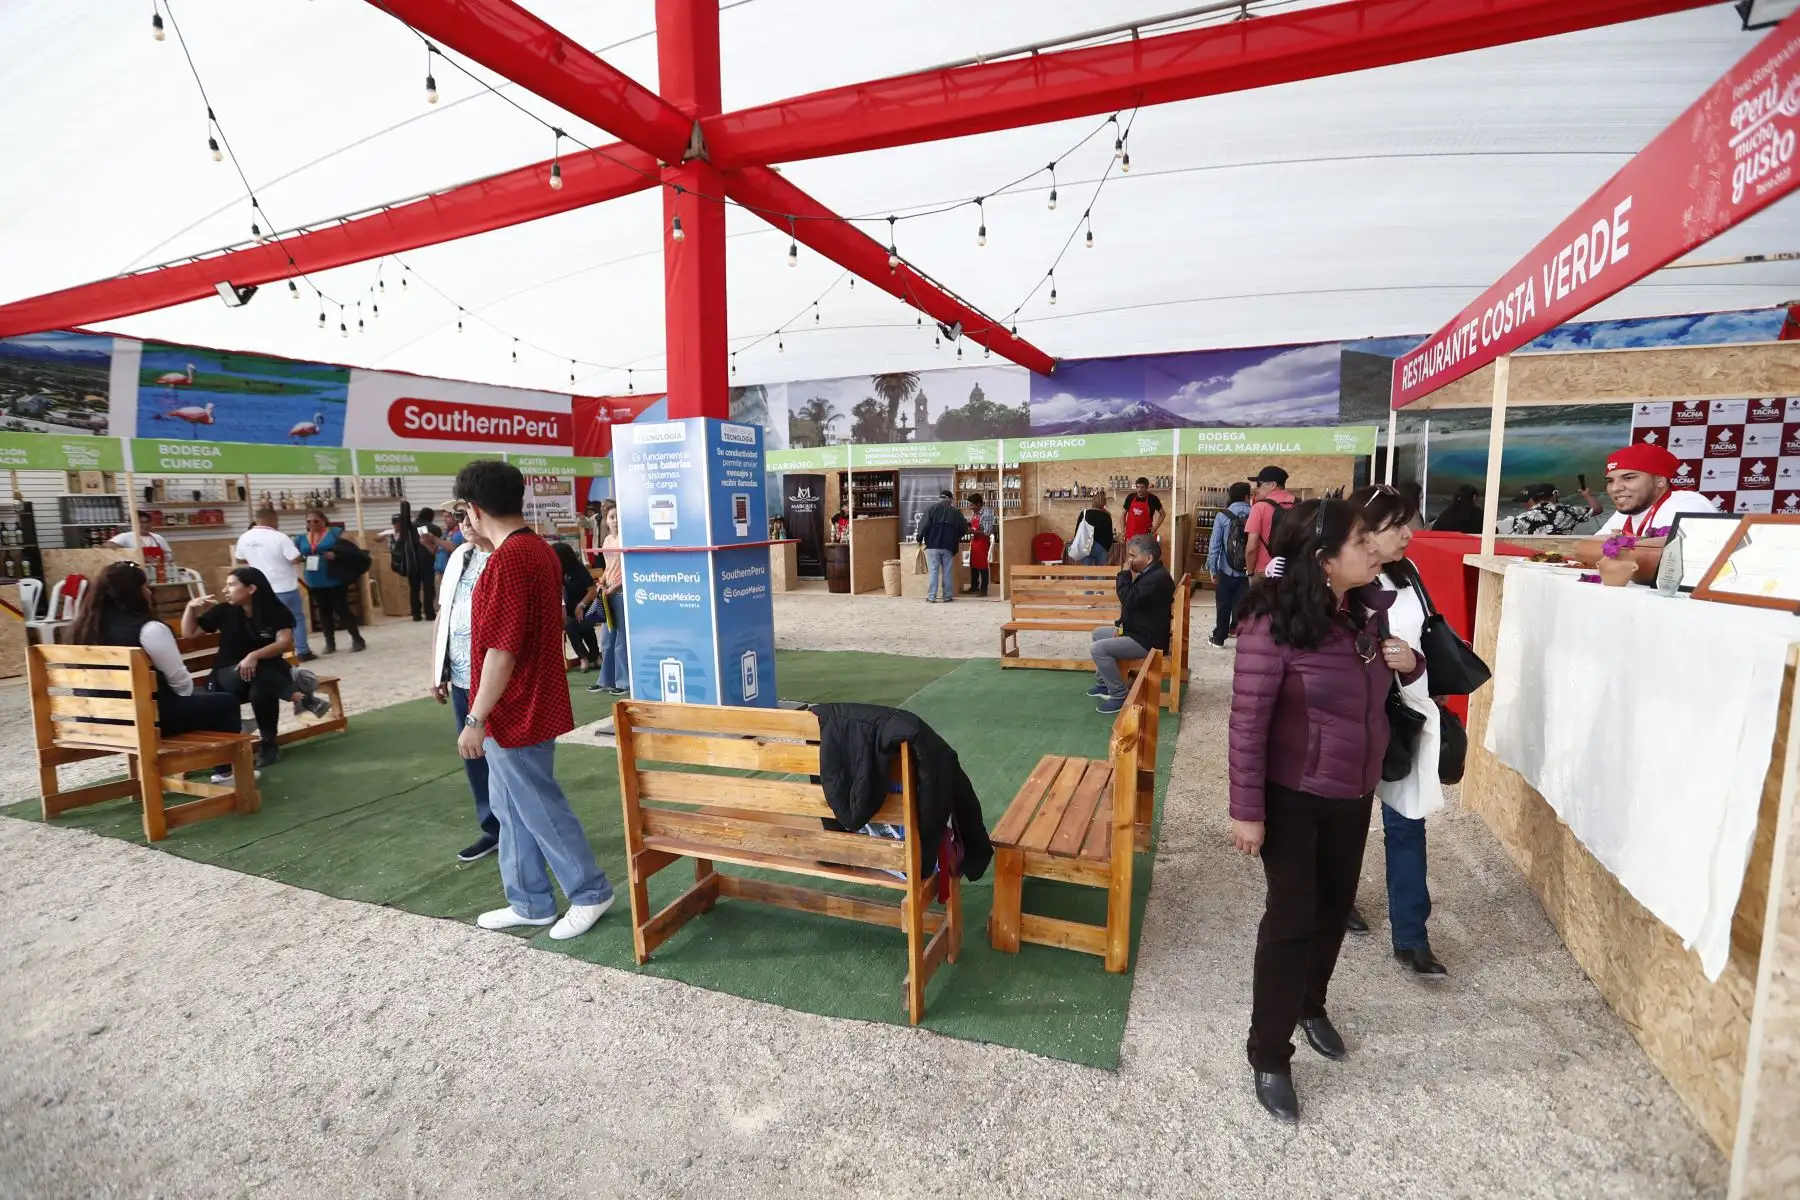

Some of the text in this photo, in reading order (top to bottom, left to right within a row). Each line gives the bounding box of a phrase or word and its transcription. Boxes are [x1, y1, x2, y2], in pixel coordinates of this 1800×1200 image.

[1735, 122, 1775, 161] mucho
[1732, 129, 1796, 204] gusto
[1402, 195, 1632, 391] RESTAURANTE COSTA VERDE
[404, 405, 558, 439] SouthernPerú
[724, 433, 754, 443] TECNOLOGÍA
[1199, 432, 1246, 441] BODEGA
[1020, 439, 1086, 449] GIANFRANCO
[1199, 442, 1302, 452] FINCA MARAVILLA
[159, 444, 222, 457] BODEGA
[716, 447, 758, 458] Su conductividad
[1020, 450, 1059, 459] VARGAS
[160, 458, 213, 469] CUNEO
[722, 460, 742, 468] permite
[772, 460, 813, 470] CARIÑOSO
[645, 481, 678, 490] de carga
[720, 479, 737, 487] recibir
[632, 571, 701, 583] SouthernPerú
[721, 564, 765, 581] SouthernPerú
[732, 584, 766, 597] GrupoMéxico
[648, 591, 701, 602] GrupoMéxico
